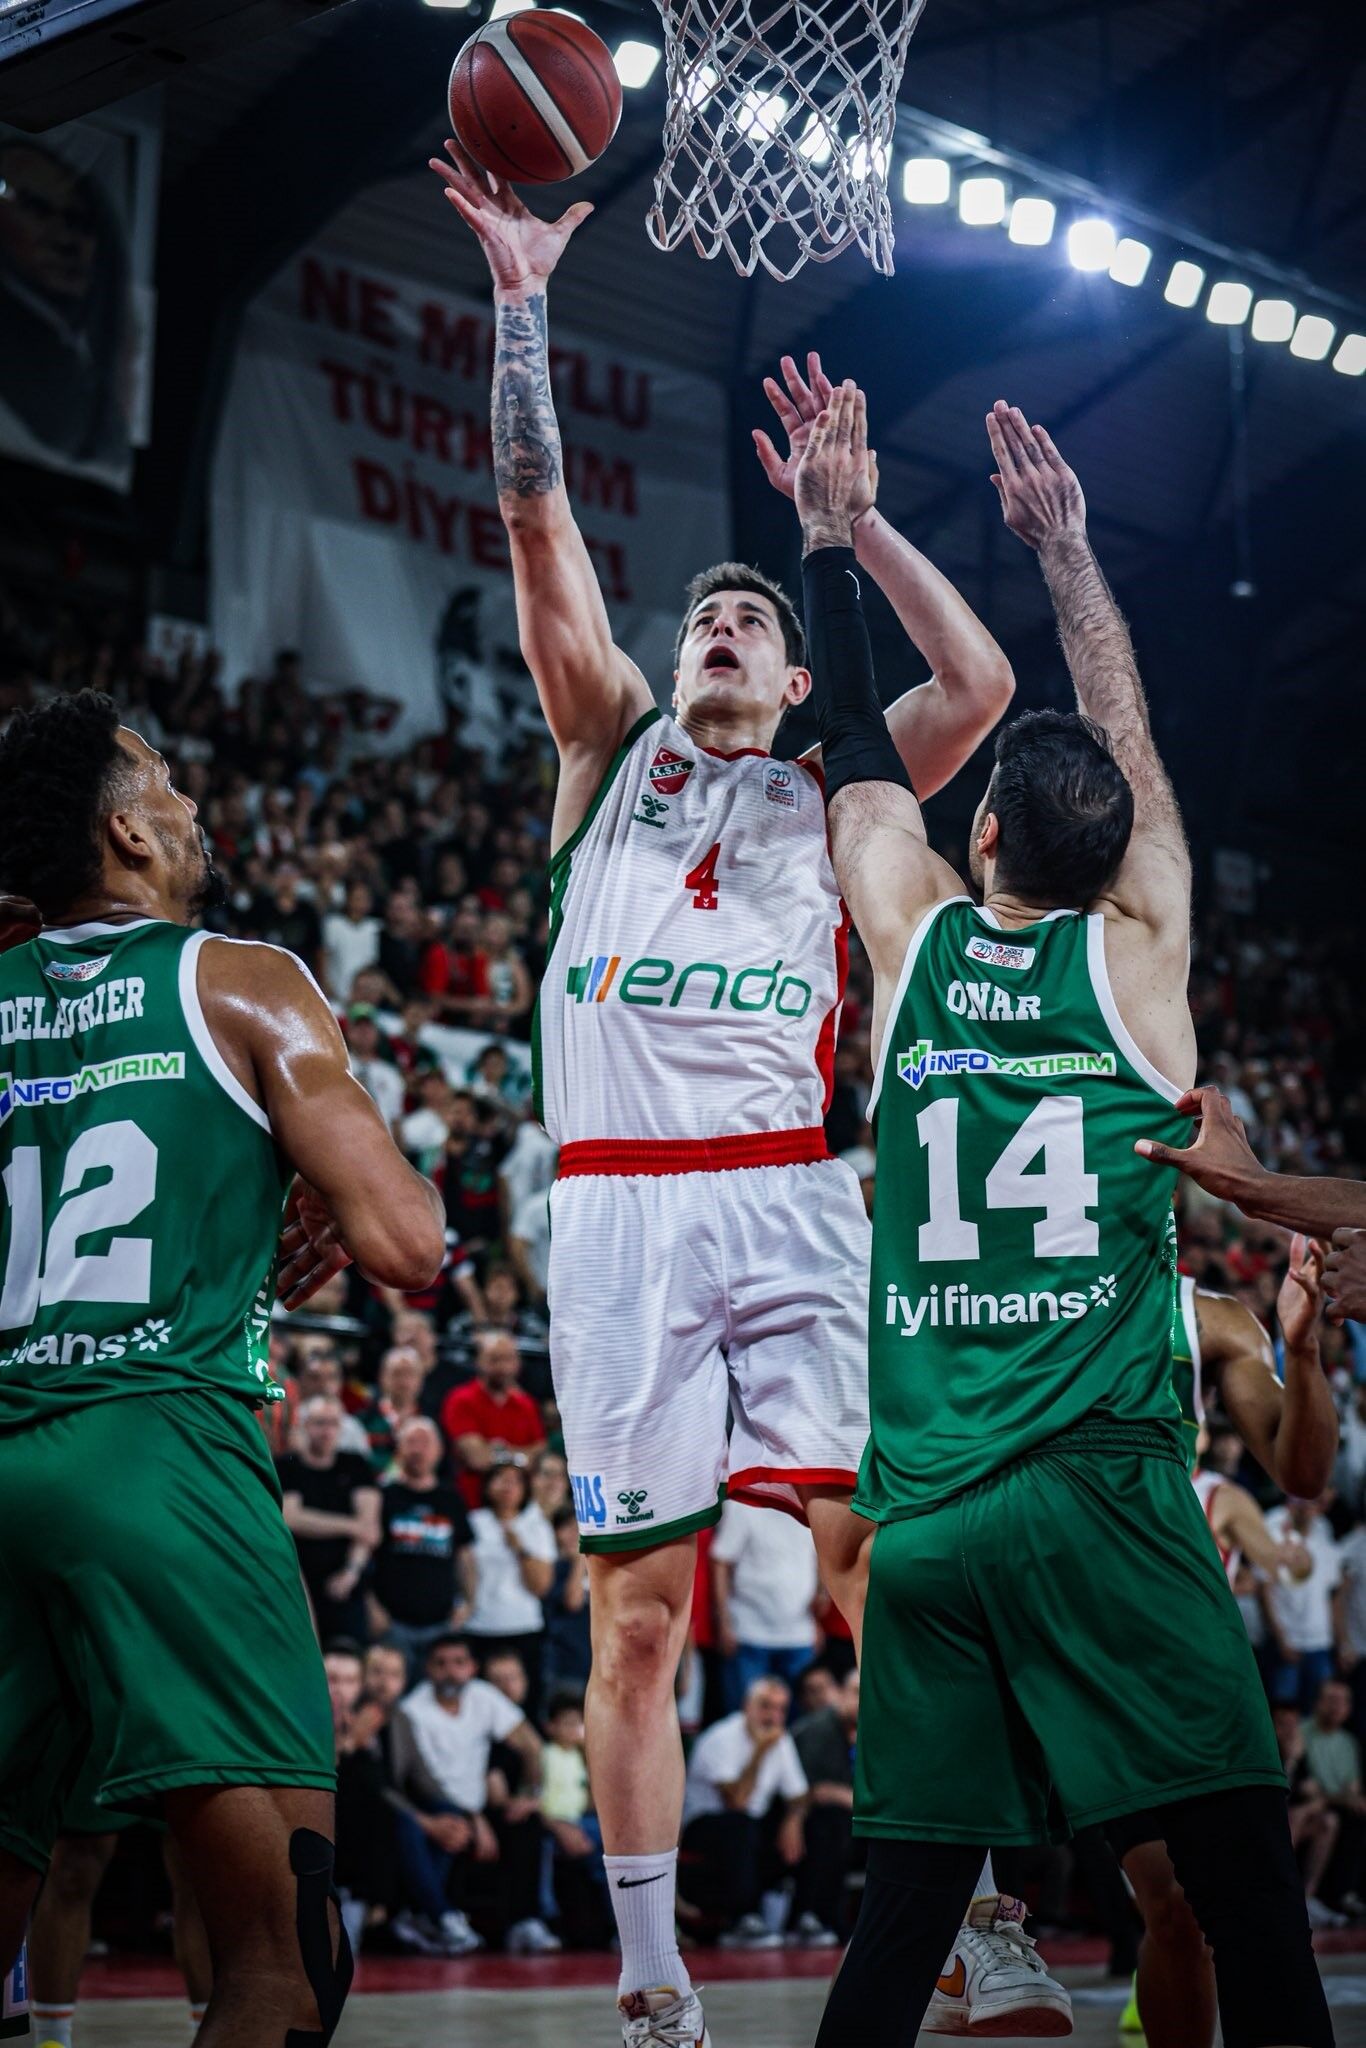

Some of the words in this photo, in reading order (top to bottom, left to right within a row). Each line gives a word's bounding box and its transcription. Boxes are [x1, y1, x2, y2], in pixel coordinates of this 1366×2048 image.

[301, 256, 397, 349] NE
[652, 763, 688, 777] K.S.K.
[684, 842, 721, 910] 4
[0, 977, 145, 1045] DELAURIER
[946, 980, 1041, 1021] ONAR
[916, 1096, 1099, 1262] 14
[0, 1120, 158, 1330] 12
[886, 1282, 1088, 1336] iyifinans
[616, 1510, 654, 1525] hummel
